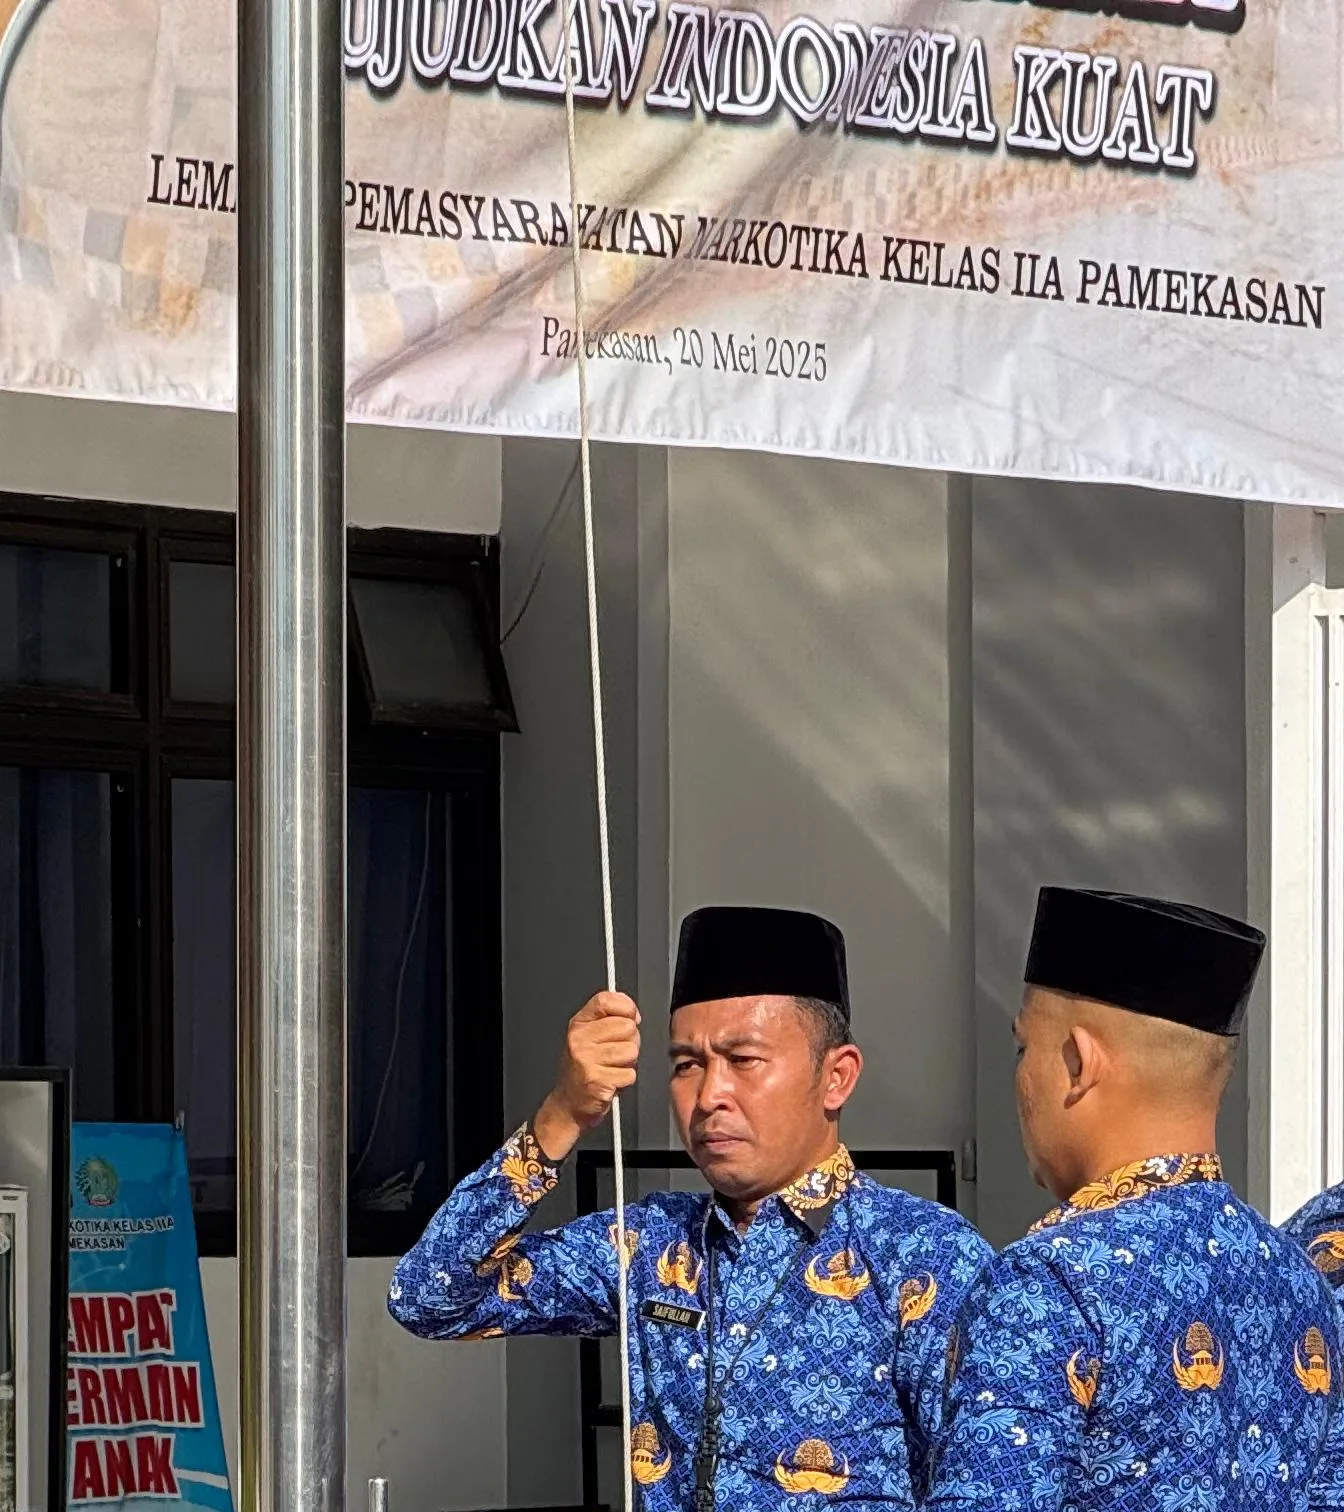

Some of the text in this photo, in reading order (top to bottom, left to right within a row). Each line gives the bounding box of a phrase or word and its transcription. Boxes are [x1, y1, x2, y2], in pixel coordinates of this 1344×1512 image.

[647, 2, 996, 142] INDONESIA
[1008, 47, 1213, 168] KUAT
[147, 155, 237, 213] LEM
[685, 216, 869, 278] NARKOTIKA
[880, 236, 1000, 296] KELAS
[1010, 252, 1064, 300] IIA
[1076, 259, 1325, 328] PAMEKASAN
[540, 316, 827, 382] Paekasan, 20 Mei 2025
[113, 1218, 154, 1232] KELAS
[67, 1293, 174, 1354] MPAT
[72, 1436, 179, 1499] ANAK
